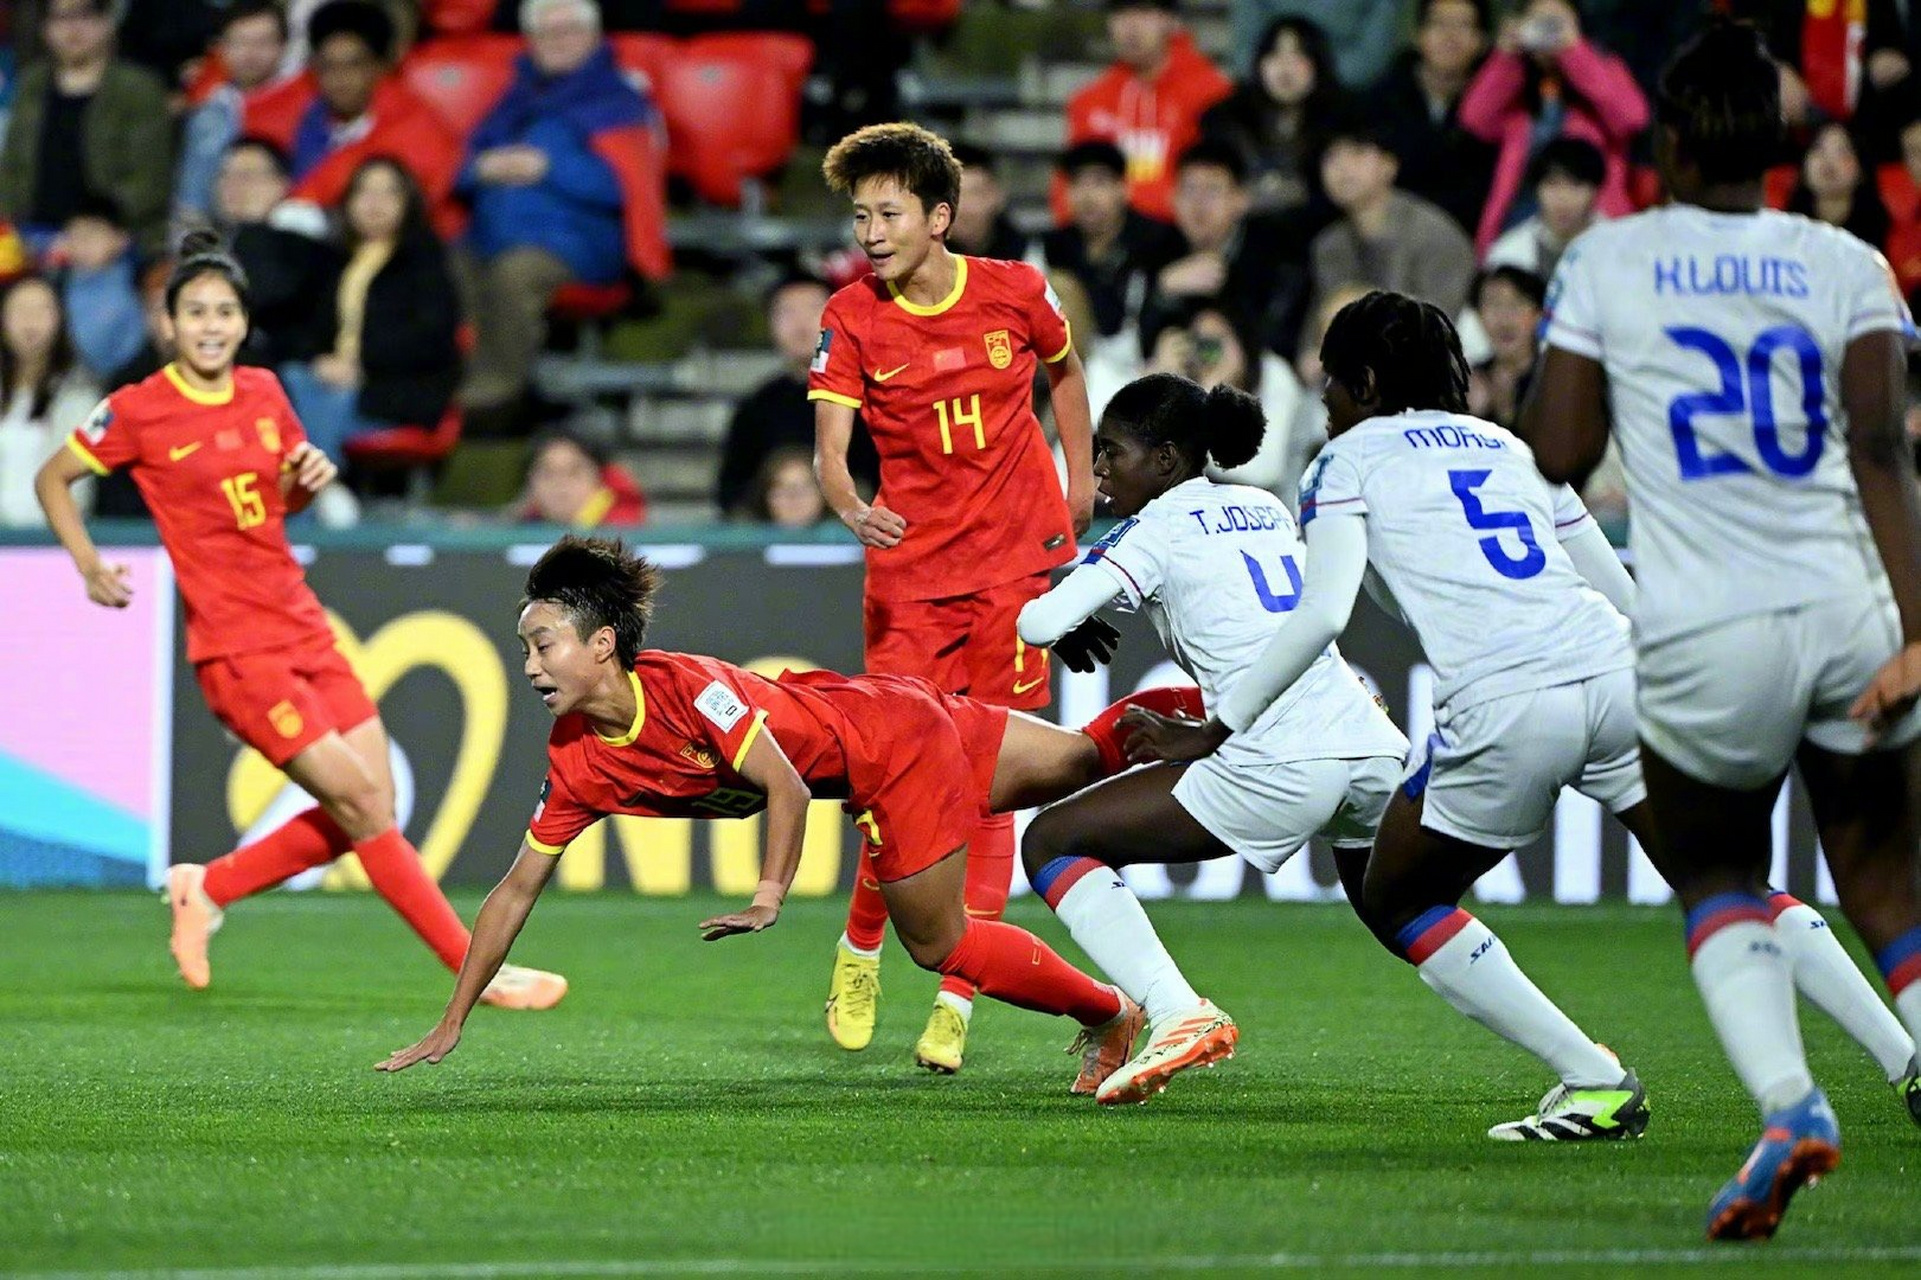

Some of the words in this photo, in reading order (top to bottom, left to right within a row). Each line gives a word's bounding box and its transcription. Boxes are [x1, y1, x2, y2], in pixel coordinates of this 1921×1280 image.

[932, 393, 986, 455] 14
[1663, 323, 1827, 483] 20
[220, 471, 267, 531] 15
[1447, 469, 1547, 580] 5
